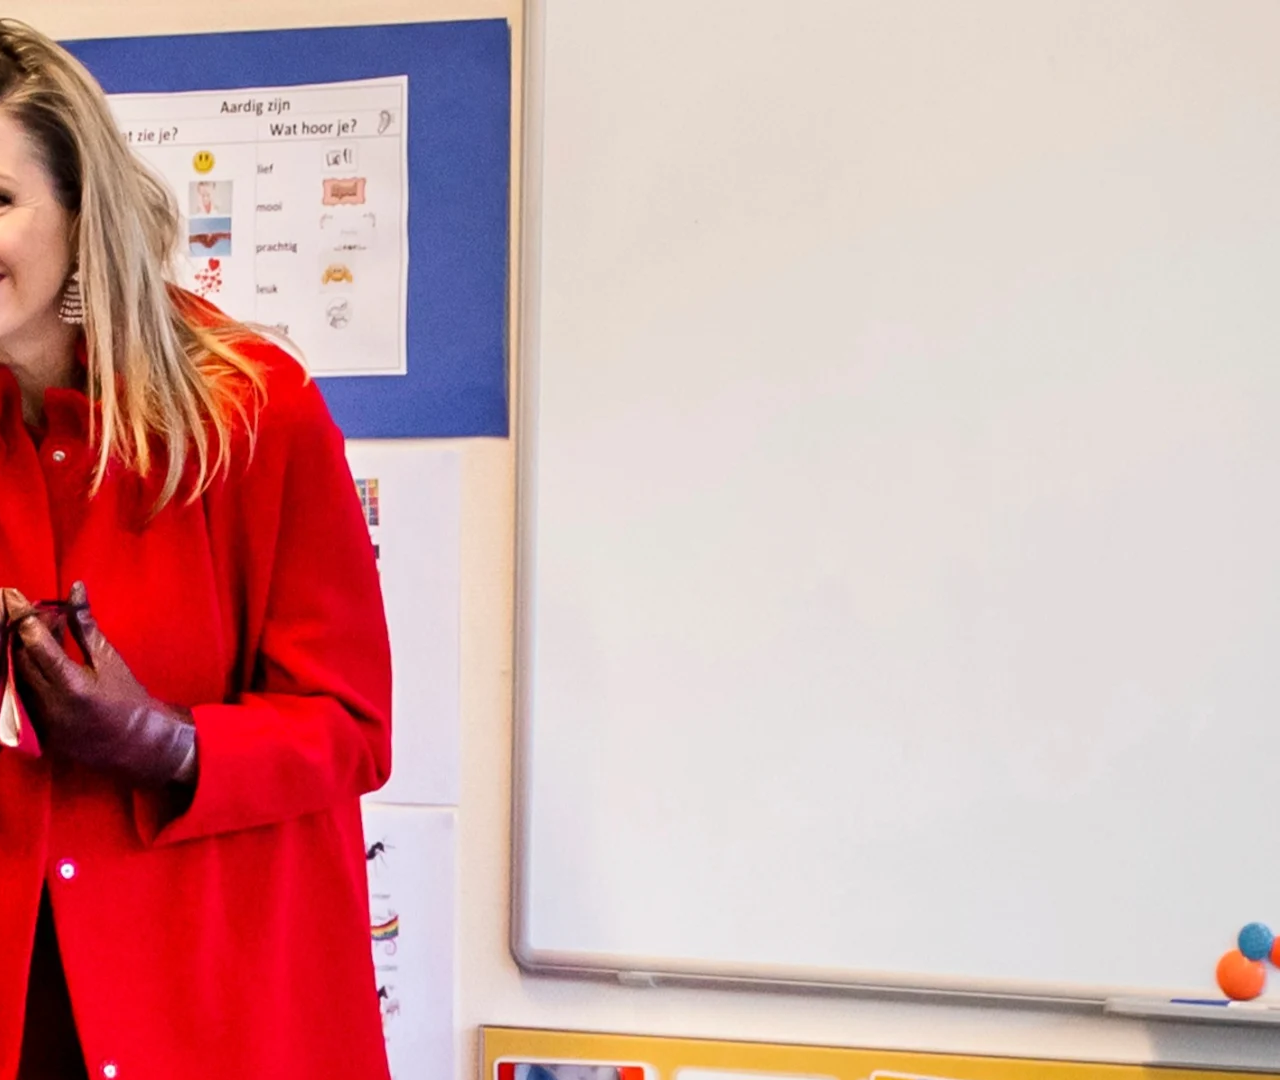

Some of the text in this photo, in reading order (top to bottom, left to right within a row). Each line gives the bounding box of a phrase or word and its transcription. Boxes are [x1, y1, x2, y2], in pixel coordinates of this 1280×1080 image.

[221, 100, 290, 116] Aardig zijn
[270, 119, 357, 136] Wat hoor je?
[137, 132, 154, 142] zie
[158, 127, 178, 144] je?
[256, 164, 274, 174] lief
[255, 202, 282, 212] mooi
[256, 241, 298, 254] prachtig
[256, 284, 278, 294] leuk
